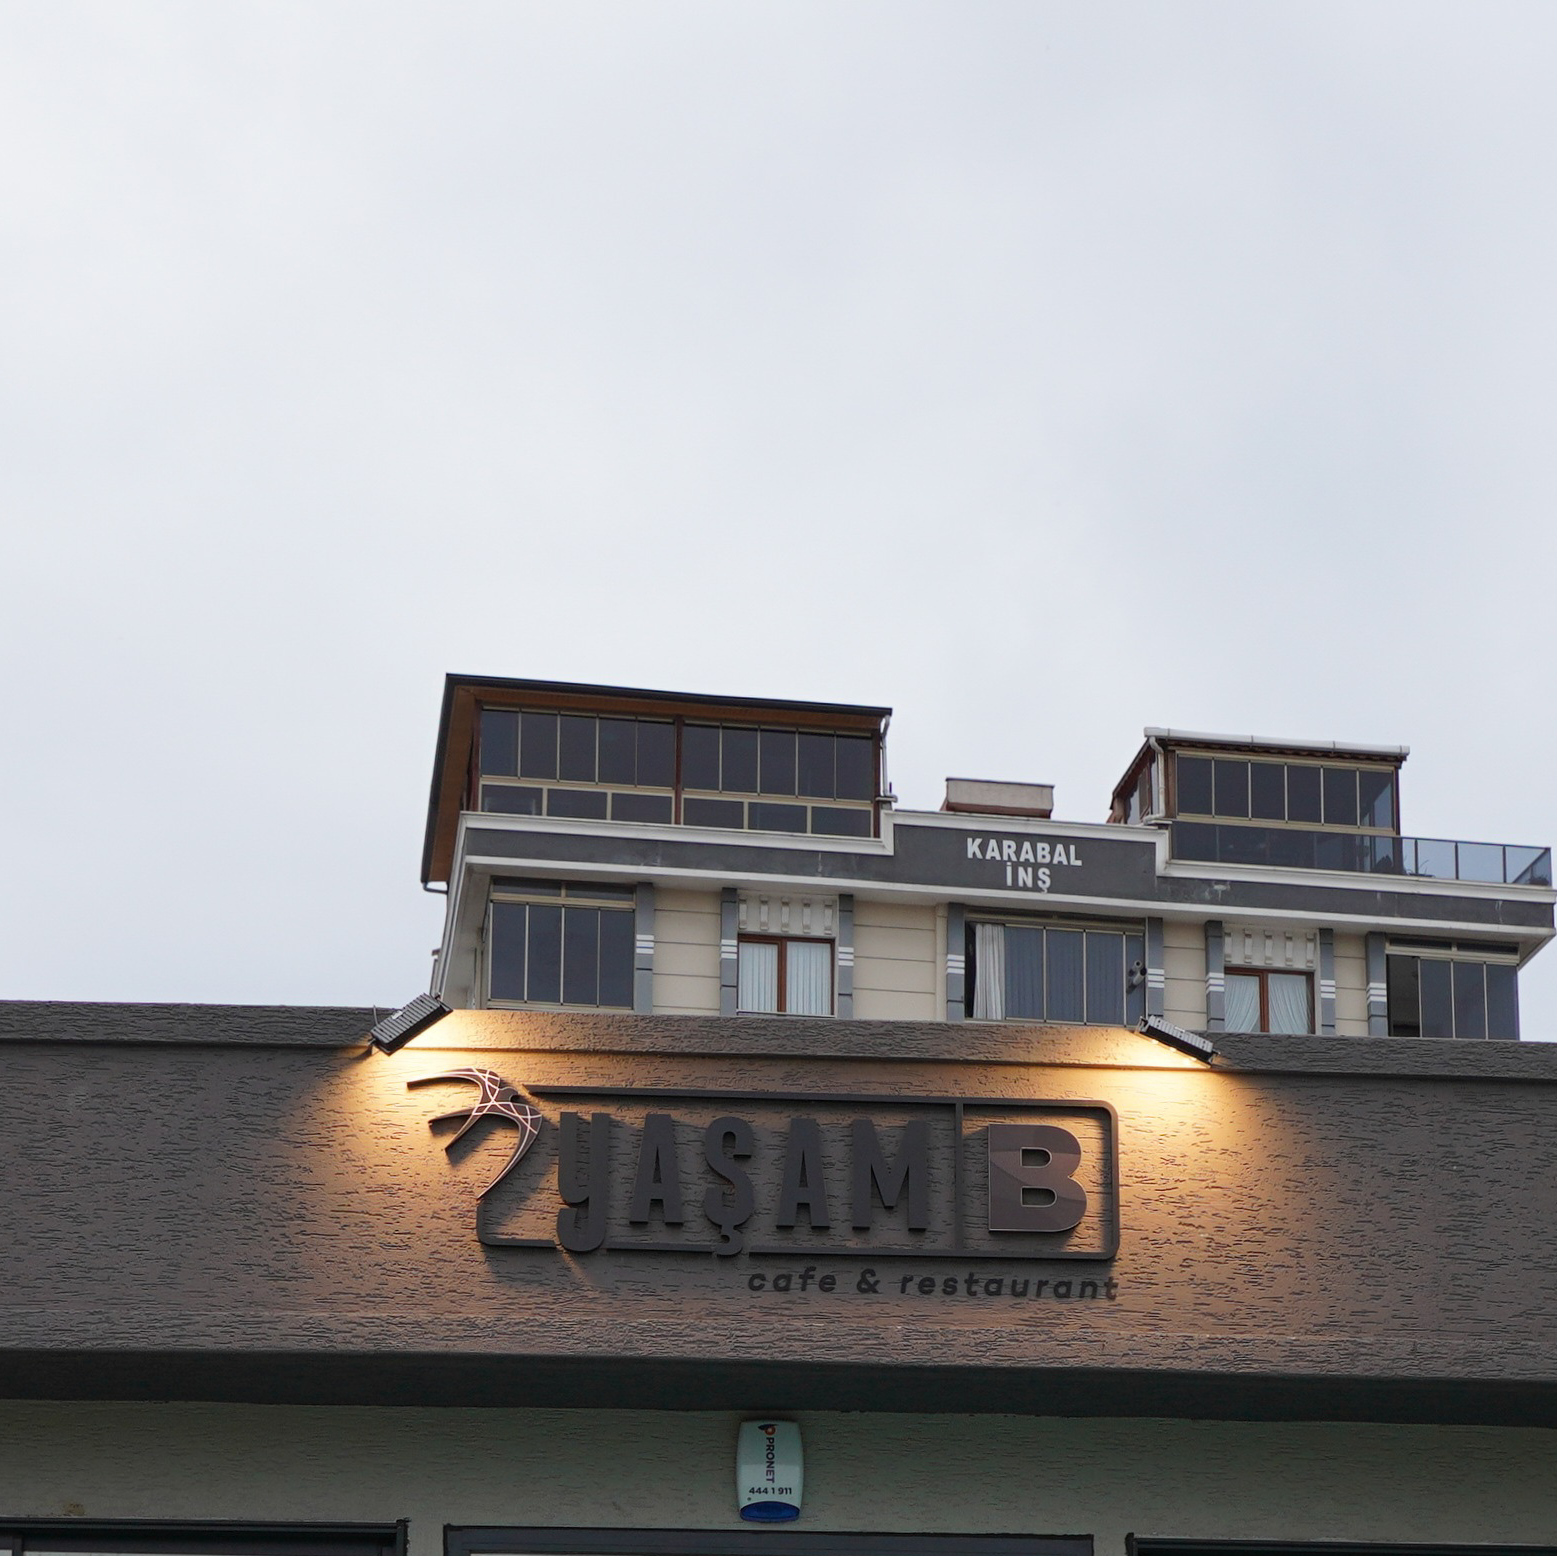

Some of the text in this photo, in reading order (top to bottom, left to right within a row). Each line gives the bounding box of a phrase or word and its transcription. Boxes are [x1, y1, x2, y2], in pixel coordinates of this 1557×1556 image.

[966, 837, 1083, 866] KARABAL
[1006, 862, 1051, 893] İNŞ
[556, 1110, 1087, 1257] YAŞAM B
[747, 1267, 1120, 1302] cafe & restaurant
[765, 1437, 775, 1483] PRONET
[748, 1487, 792, 1495] 444 1 911
